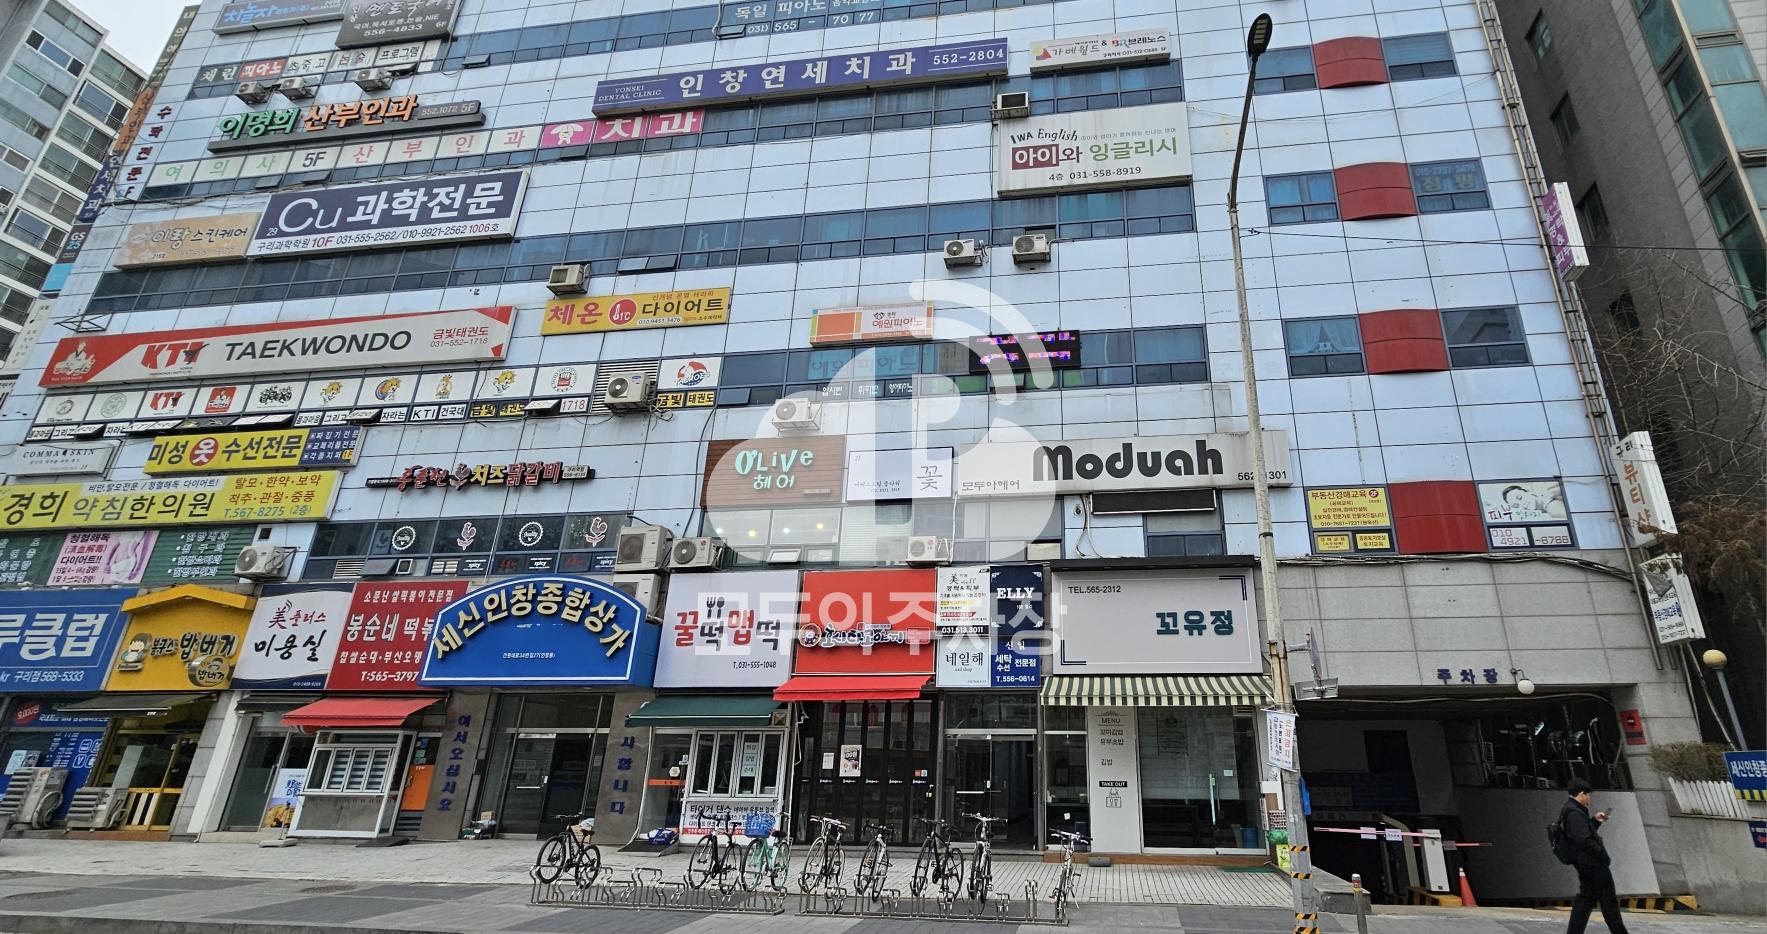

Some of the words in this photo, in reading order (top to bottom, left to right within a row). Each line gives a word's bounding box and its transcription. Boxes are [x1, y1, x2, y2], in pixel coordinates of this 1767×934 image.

[735, 4, 767, 20] 독일
[777, 0, 826, 14] 피아노
[748, 24, 769, 34] 031)
[774, 19, 797, 32] 565
[833, 15, 849, 24] 70
[859, 12, 874, 22] 77
[241, 61, 283, 77] 피아노
[380, 45, 420, 60] 프로그램
[679, 51, 916, 98] 인창연세치과
[933, 48, 1005, 66] 552-2804
[599, 92, 630, 103] DENTAL
[633, 89, 662, 98] CLINIC
[615, 84, 645, 94] YONSEI
[461, 103, 475, 113] 5F
[219, 105, 301, 139] 이명희
[303, 94, 419, 131] 산부인과
[601, 110, 698, 139] 치과
[1037, 128, 1079, 142] English
[1015, 145, 1083, 167] 아이와
[1089, 136, 1178, 162] 잉글리시
[302, 152, 326, 168] 5F
[1049, 173, 1064, 182] 4층
[1069, 166, 1142, 180] 031-558-8919
[278, 198, 342, 232] Cu
[346, 181, 504, 226] 과학전문
[71, 232, 87, 241] GS
[190, 227, 248, 243] 스킨케어
[311, 236, 335, 248] 10F
[336, 225, 467, 245] 031-555-2562/010-9921-2562
[468, 223, 500, 234] 1006호
[67, 241, 82, 250] 25
[546, 302, 603, 327] 체온
[641, 298, 724, 317] 다이어트
[433, 326, 489, 340] 금빛태권도
[225, 330, 412, 362] TAEKWONDO
[430, 337, 488, 349] 031-552-1718
[658, 394, 683, 406] 금빛
[688, 392, 714, 404] 태권도
[382, 409, 406, 421] 자라는
[413, 409, 436, 419] KTI
[440, 405, 465, 417] 건국대
[472, 404, 496, 416] 금빛
[562, 399, 586, 411] 1718
[23, 450, 60, 459] COMMA
[70, 448, 95, 456] SKIN
[147, 440, 189, 466] 미성
[191, 438, 216, 465] 옷
[221, 433, 303, 462] 수선전문
[470, 460, 562, 487] 치즈닭갈비
[916, 464, 944, 491] 꽃
[183, 478, 220, 488] 다이어트!
[753, 473, 796, 491] 헤어
[4, 490, 69, 526] 경희
[224, 506, 285, 519] T.567-8275
[1500, 537, 1528, 546] 4921
[1535, 535, 1569, 545] -8788
[60, 555, 103, 564] 다이어트!!
[533, 560, 547, 569] spicy
[363, 591, 390, 603] 소문난
[428, 589, 455, 602] 전문점
[996, 587, 1035, 599] ELLY
[1068, 585, 1121, 594] TEL.565-2312
[346, 613, 400, 642] 봉순네
[432, 582, 632, 660] 세신인창종합상가
[1155, 609, 1235, 637] 꼬유정
[674, 608, 781, 653] 꿀떡맵떡
[941, 626, 984, 634] 031.513.3011
[180, 632, 236, 661] 밥버거
[253, 628, 328, 663] 미용실
[945, 651, 984, 667] 네일해
[995, 654, 1012, 664] 세탁
[1014, 658, 1037, 668] 전문점
[14, 670, 41, 683] 구리점
[41, 670, 85, 683] 568-5333
[198, 669, 225, 681] 밥버거
[360, 670, 420, 682] T:565-3797
[1437, 668, 1499, 684] 주차장
[437, 714, 472, 811] 어서오십시오
